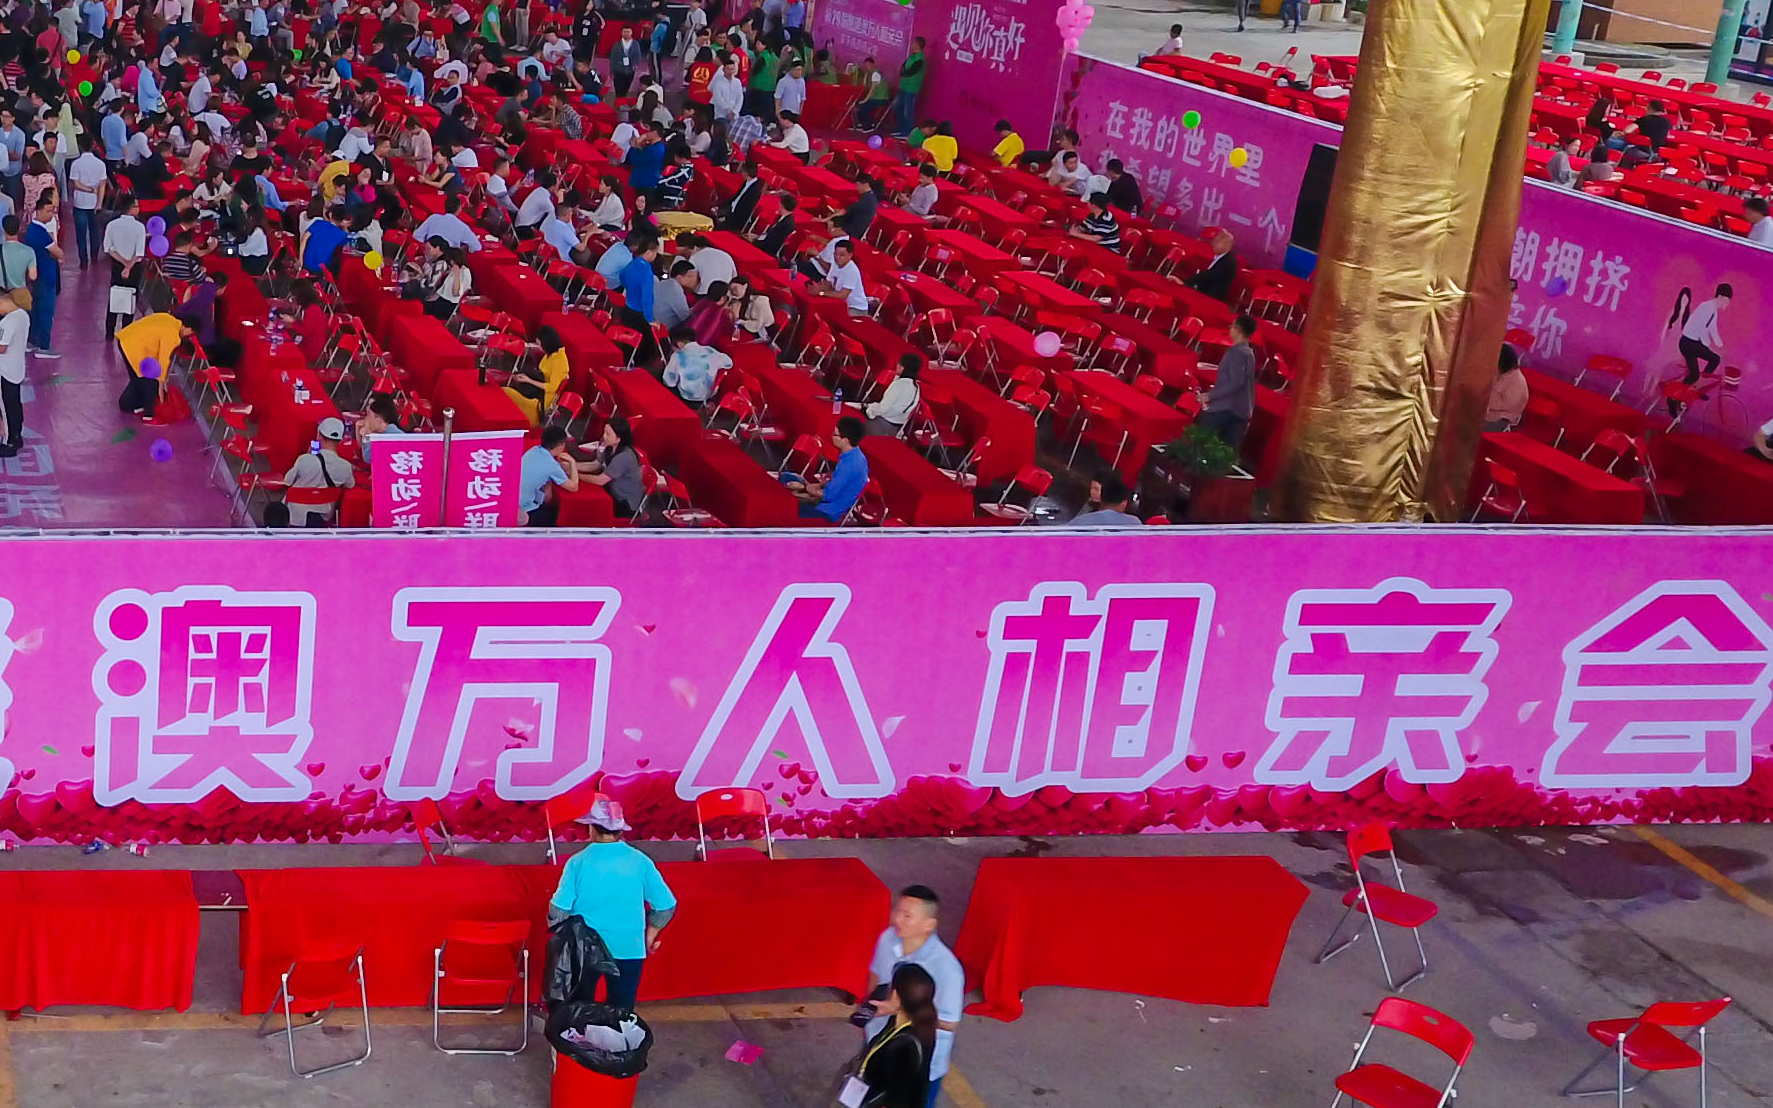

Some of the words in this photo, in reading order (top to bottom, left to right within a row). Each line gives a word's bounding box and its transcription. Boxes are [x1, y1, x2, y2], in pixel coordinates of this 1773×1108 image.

[1105, 99, 1264, 188] 在我的世界里
